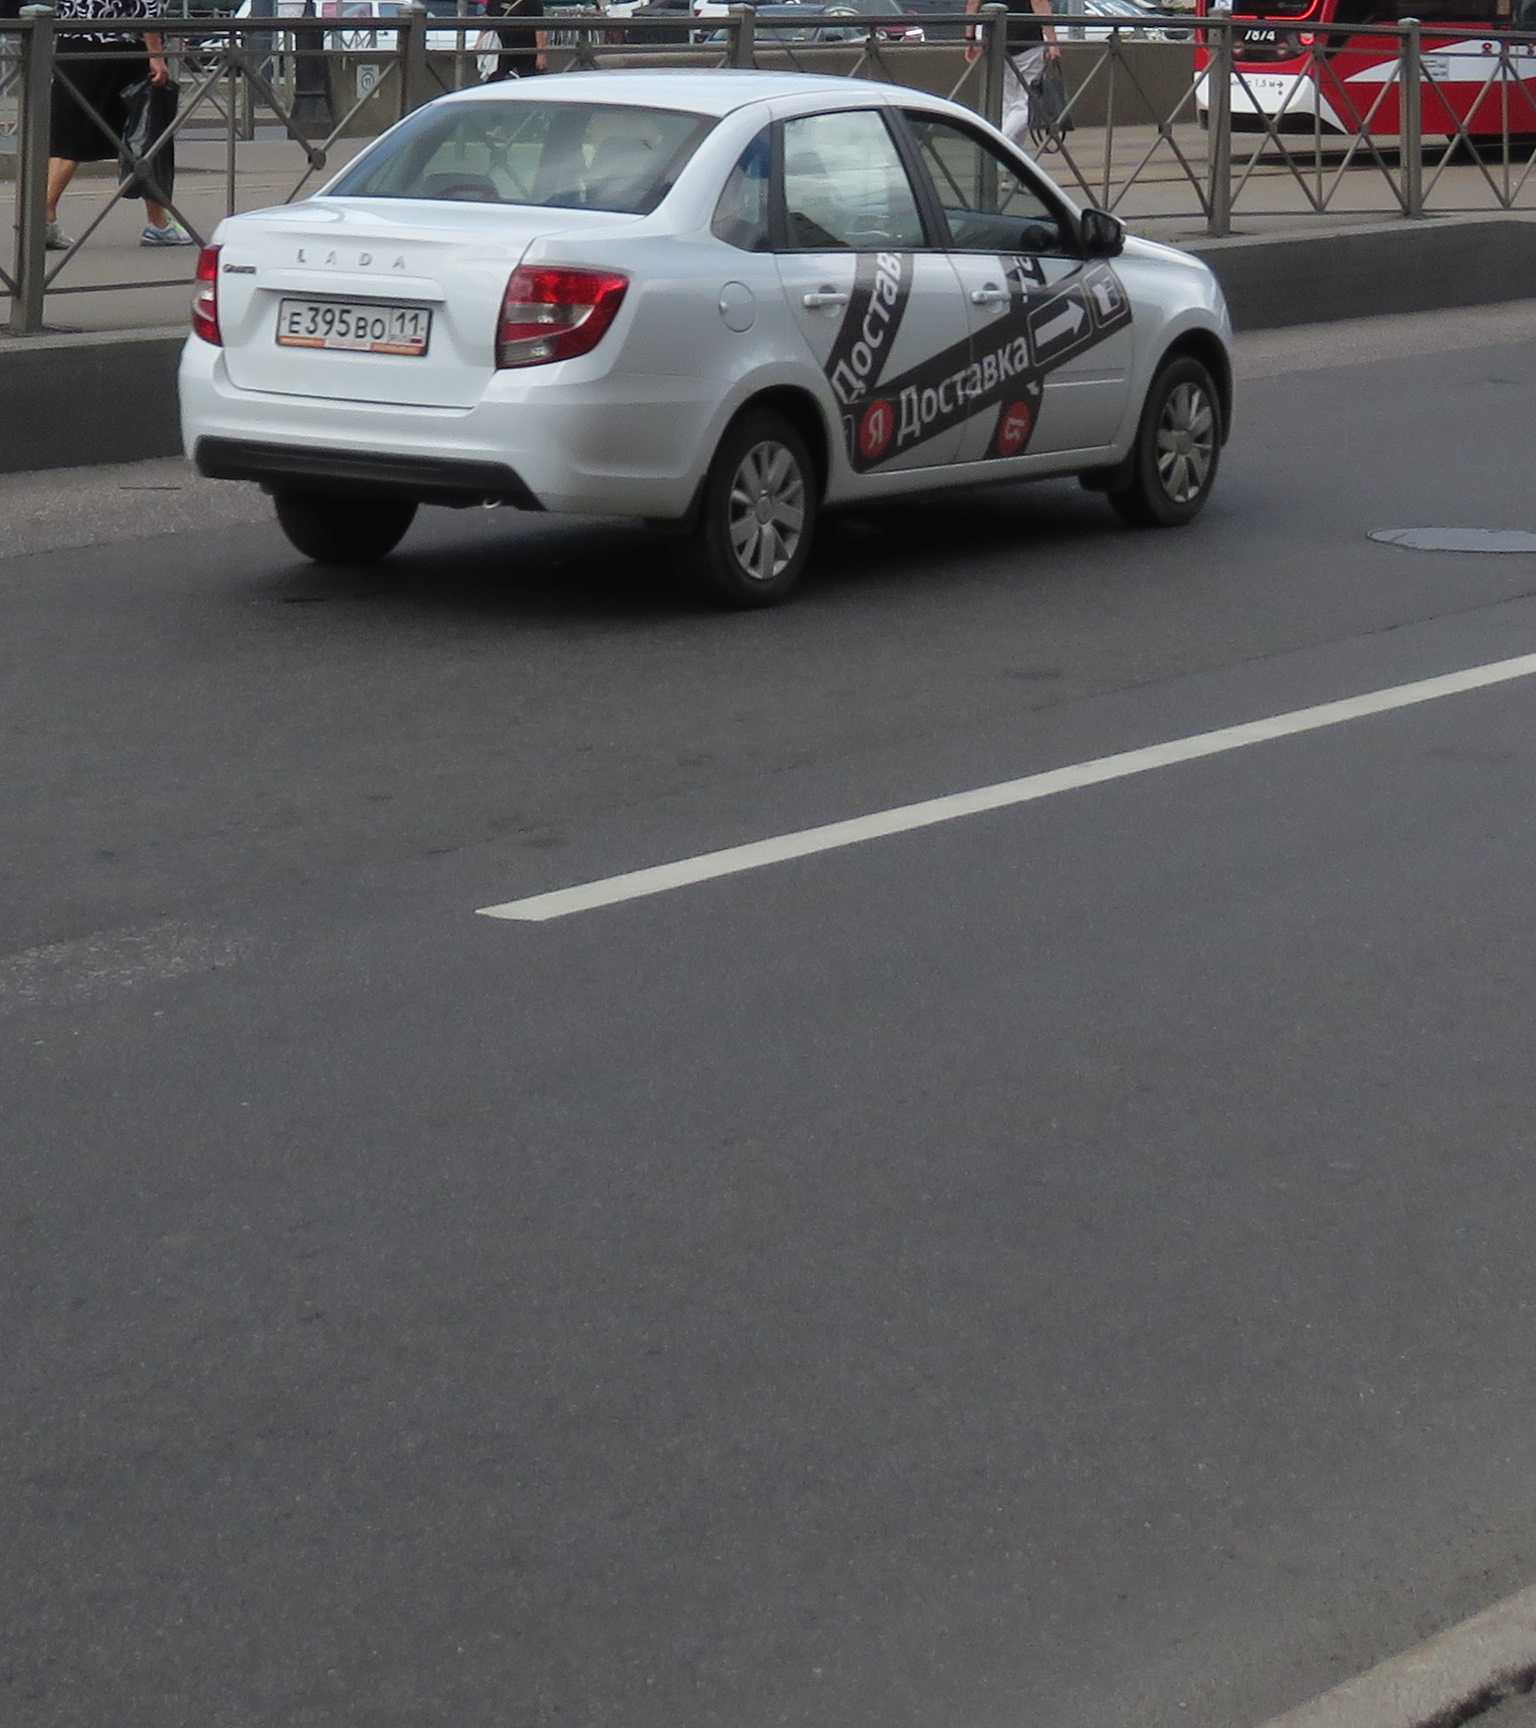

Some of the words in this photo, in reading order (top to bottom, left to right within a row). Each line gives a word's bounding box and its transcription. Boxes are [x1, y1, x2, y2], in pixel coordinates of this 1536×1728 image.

[295, 248, 406, 269] LADA
[288, 306, 386, 339] Е395ВО
[394, 312, 419, 335] 11
[830, 253, 902, 405] Достав
[896, 337, 1030, 446] Доставка
